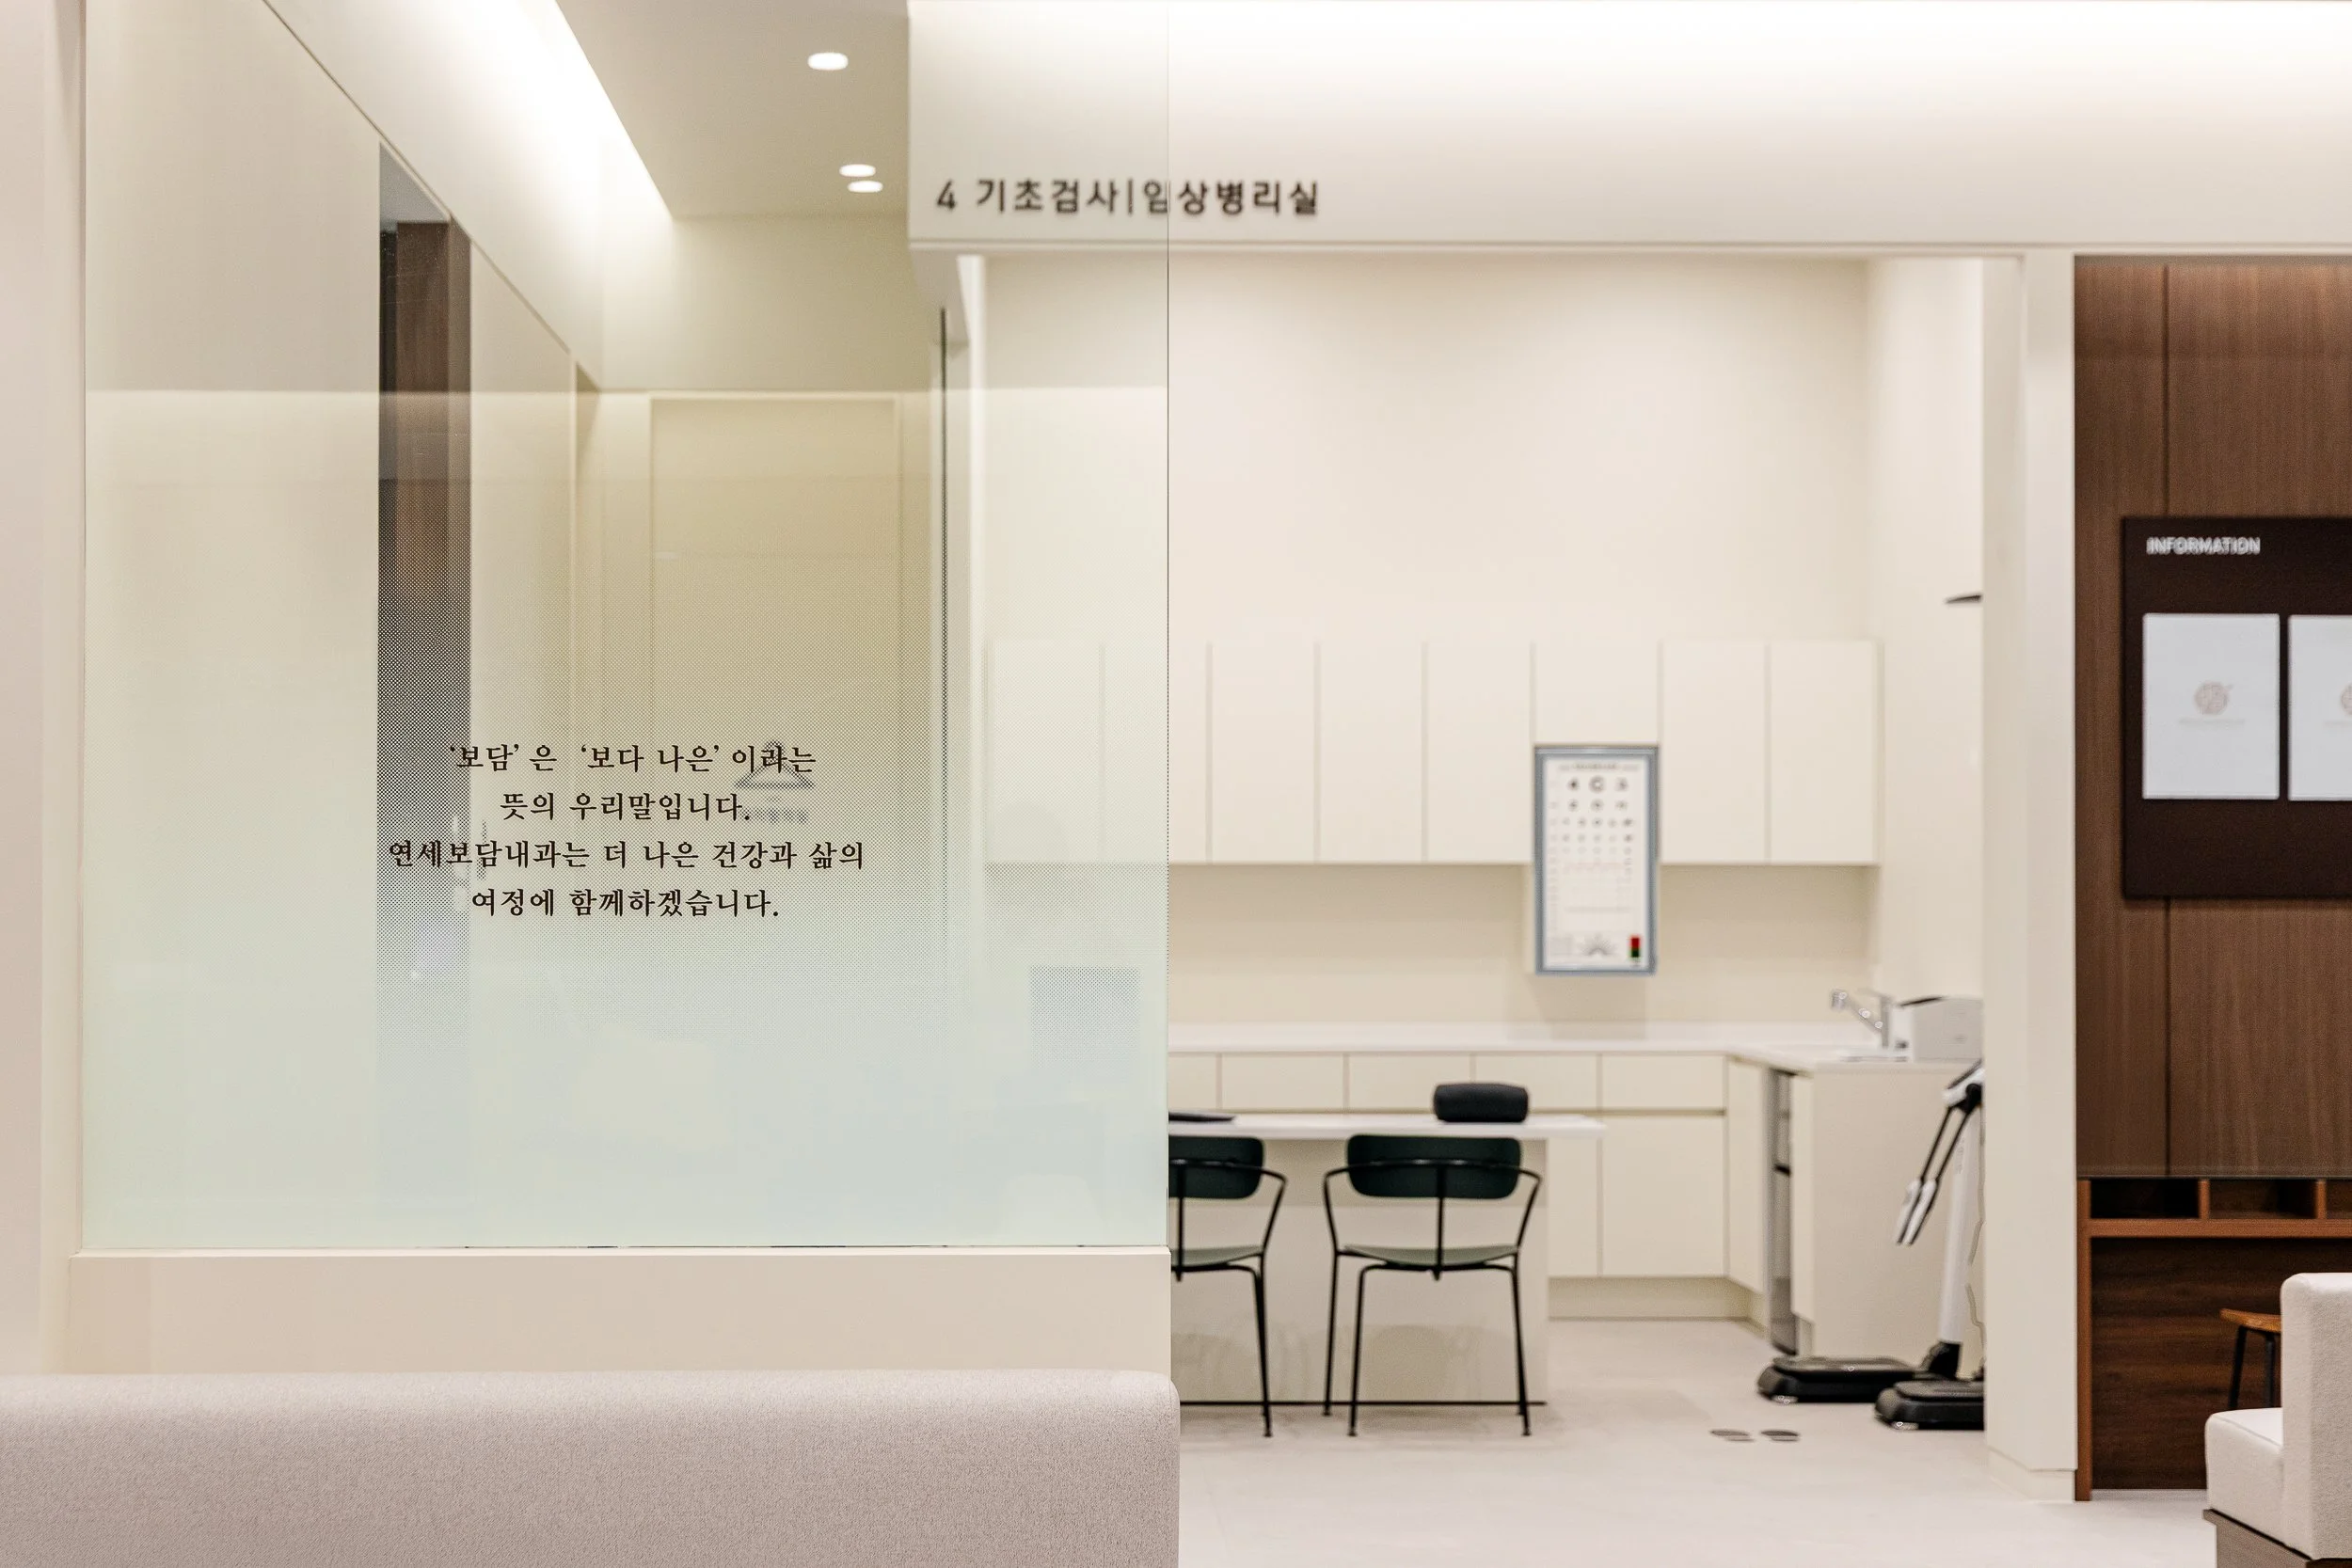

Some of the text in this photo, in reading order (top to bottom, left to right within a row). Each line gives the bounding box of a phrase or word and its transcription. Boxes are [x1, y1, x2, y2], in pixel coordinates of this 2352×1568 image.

[936, 181, 958, 211] 4
[2145, 535, 2262, 556] INFORMATION
[529, 744, 558, 772] 은
[731, 744, 817, 774] 이라는
[499, 792, 555, 821] 뜻의
[568, 792, 751, 822] 우리말입니다.
[388, 840, 865, 870] 연세보담내과는 더 나은 건강과 삶의
[470, 888, 780, 918] 여정에 함께하겠습니다.
